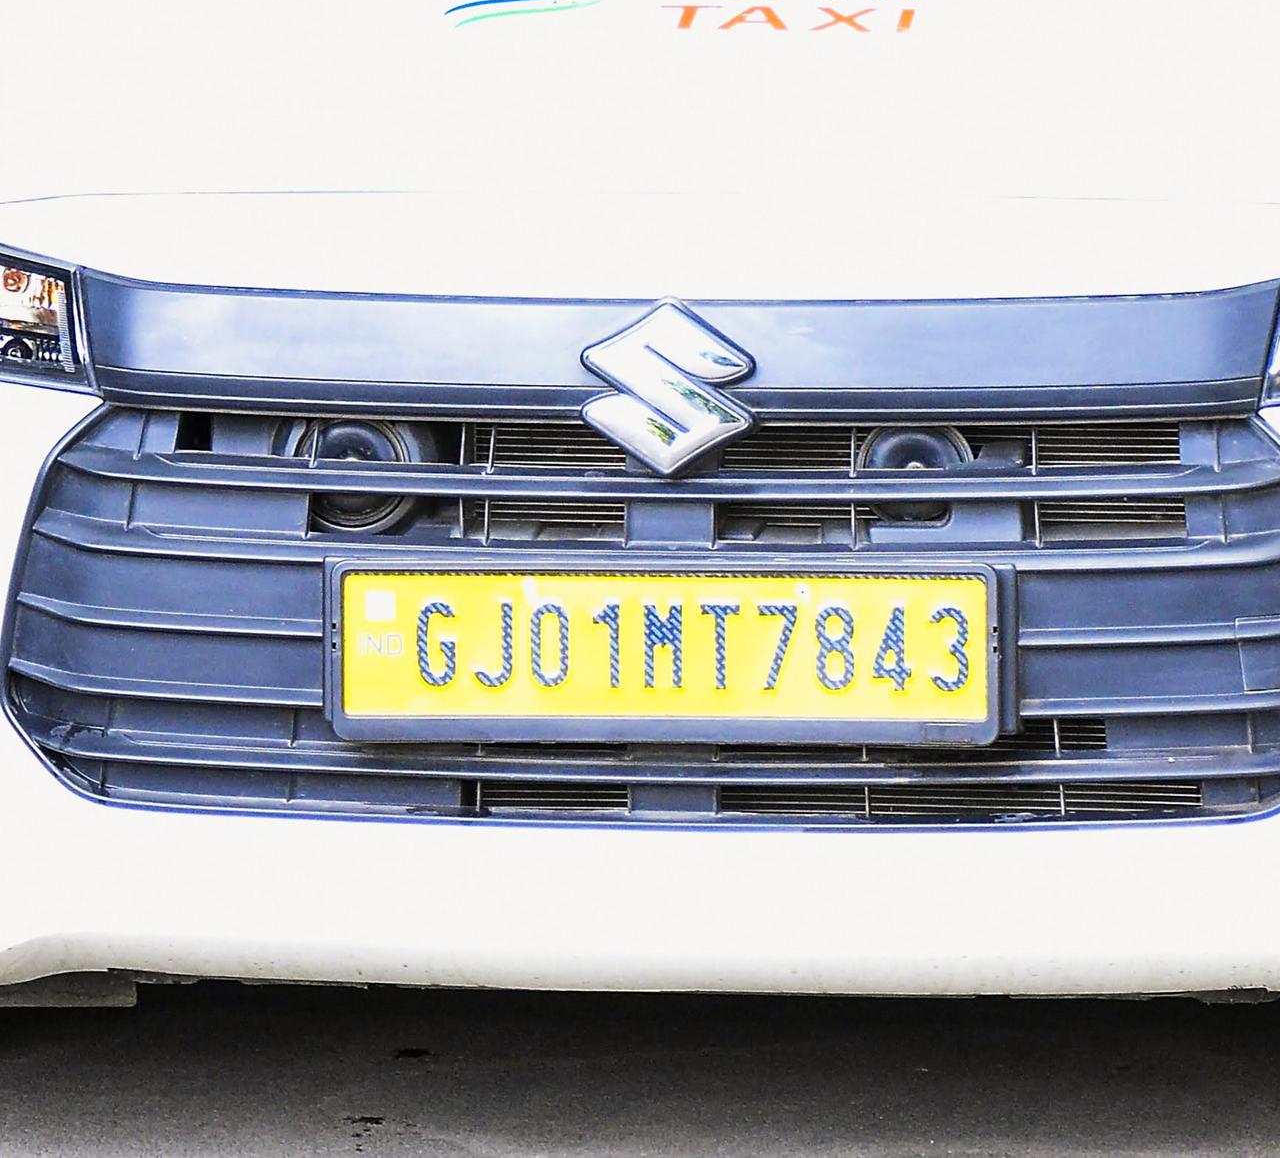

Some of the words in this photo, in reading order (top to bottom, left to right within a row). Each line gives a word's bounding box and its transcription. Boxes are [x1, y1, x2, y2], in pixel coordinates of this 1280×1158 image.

[661, 5, 916, 32] TAXI
[358, 633, 404, 656] IND
[415, 601, 971, 692] GJ01MT7843
